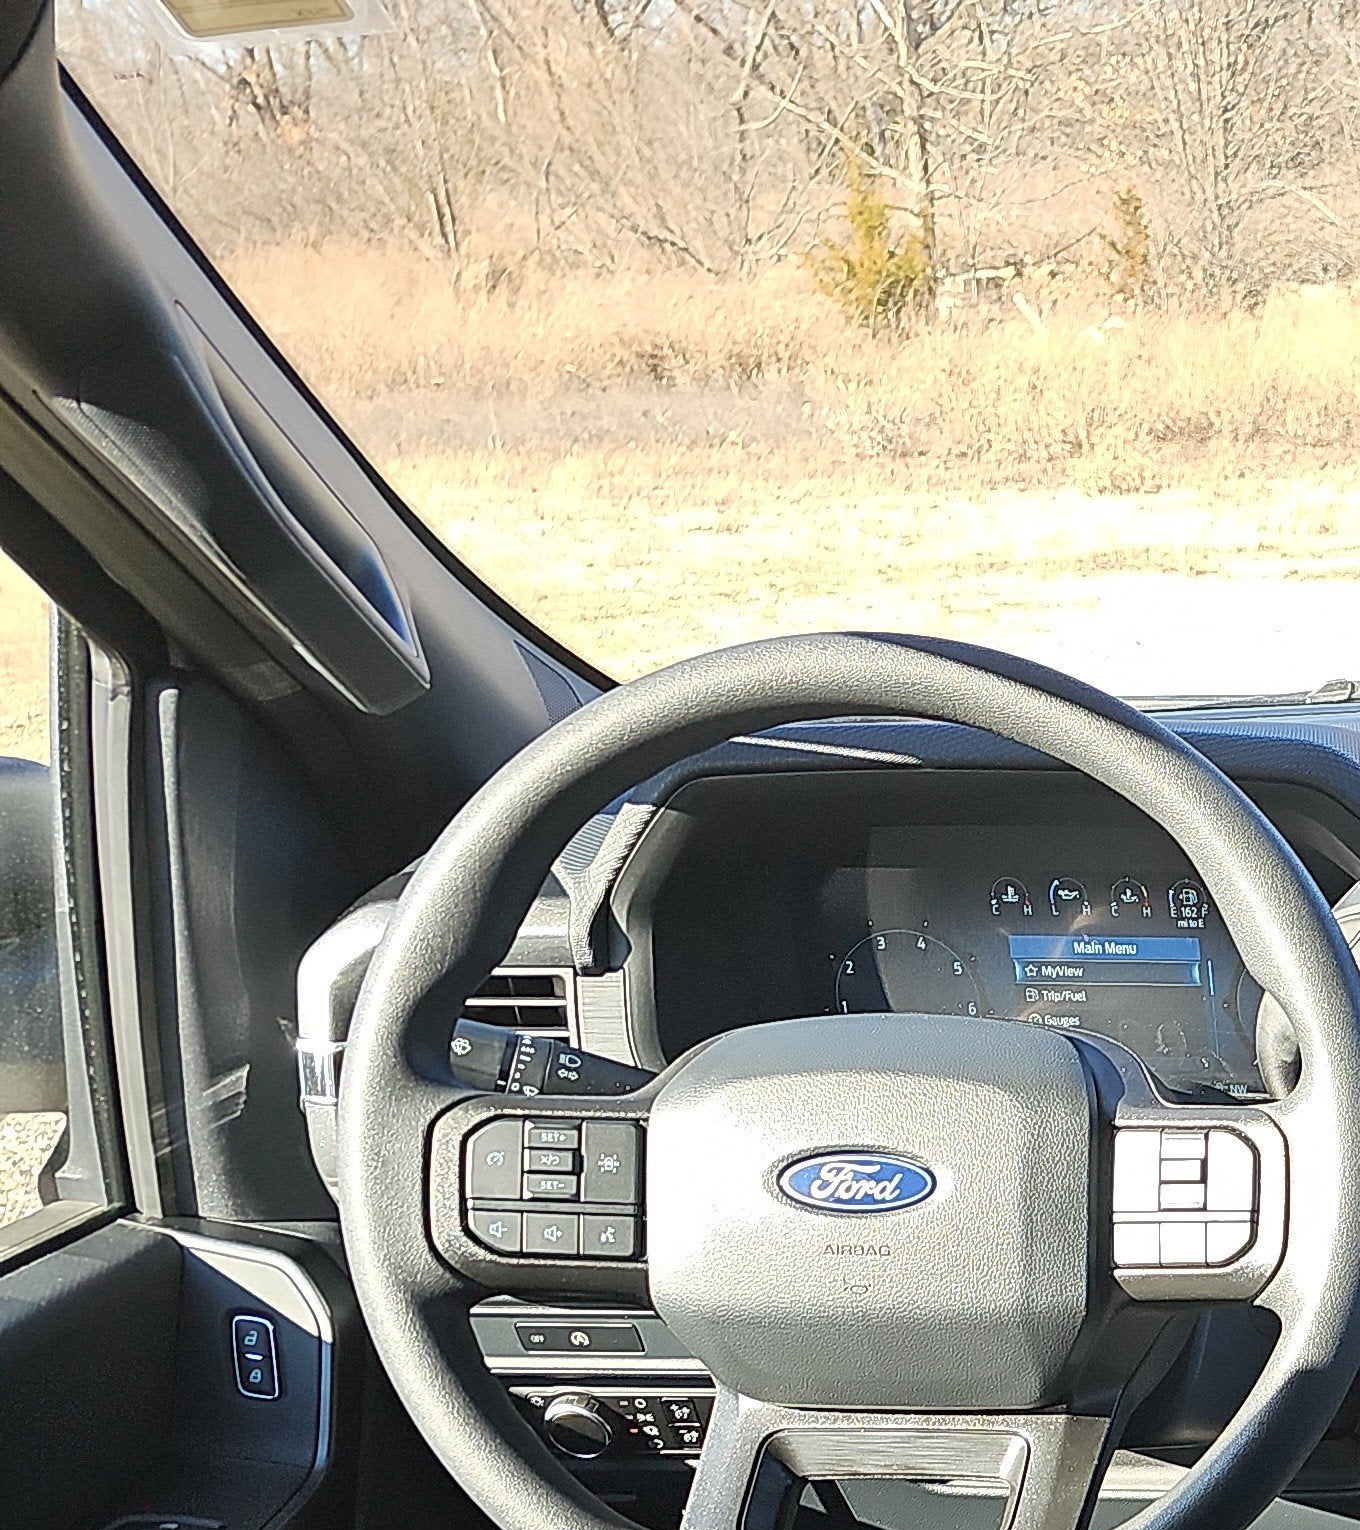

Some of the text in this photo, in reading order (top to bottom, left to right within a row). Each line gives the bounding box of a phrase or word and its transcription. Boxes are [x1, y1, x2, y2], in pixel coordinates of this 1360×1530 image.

[992, 904, 1000, 915] C
[1023, 905, 1033, 916] H
[1051, 905, 1060, 916] L
[1082, 905, 1092, 916] H
[1142, 906, 1151, 917] H
[1170, 907, 1178, 917] E
[1180, 907, 1198, 918] 162
[1201, 907, 1209, 917] F
[1189, 920, 1198, 928] to
[1198, 919, 1205, 928] E
[876, 936, 886, 950] 3
[917, 936, 926, 950] 4
[1073, 941, 1137, 954] Main Menu
[845, 961, 855, 974] 2
[953, 961, 963, 975] 5
[1041, 966, 1084, 978] MyView
[1041, 990, 1087, 1002] Trip/Fuel
[842, 1000, 848, 1013] 1
[968, 1002, 977, 1015] 6
[1044, 1015, 1080, 1026] Gauges
[1229, 1084, 1248, 1094] NW
[810, 1162, 904, 1201] Ford
[823, 1243, 891, 1257] AIRBAG
